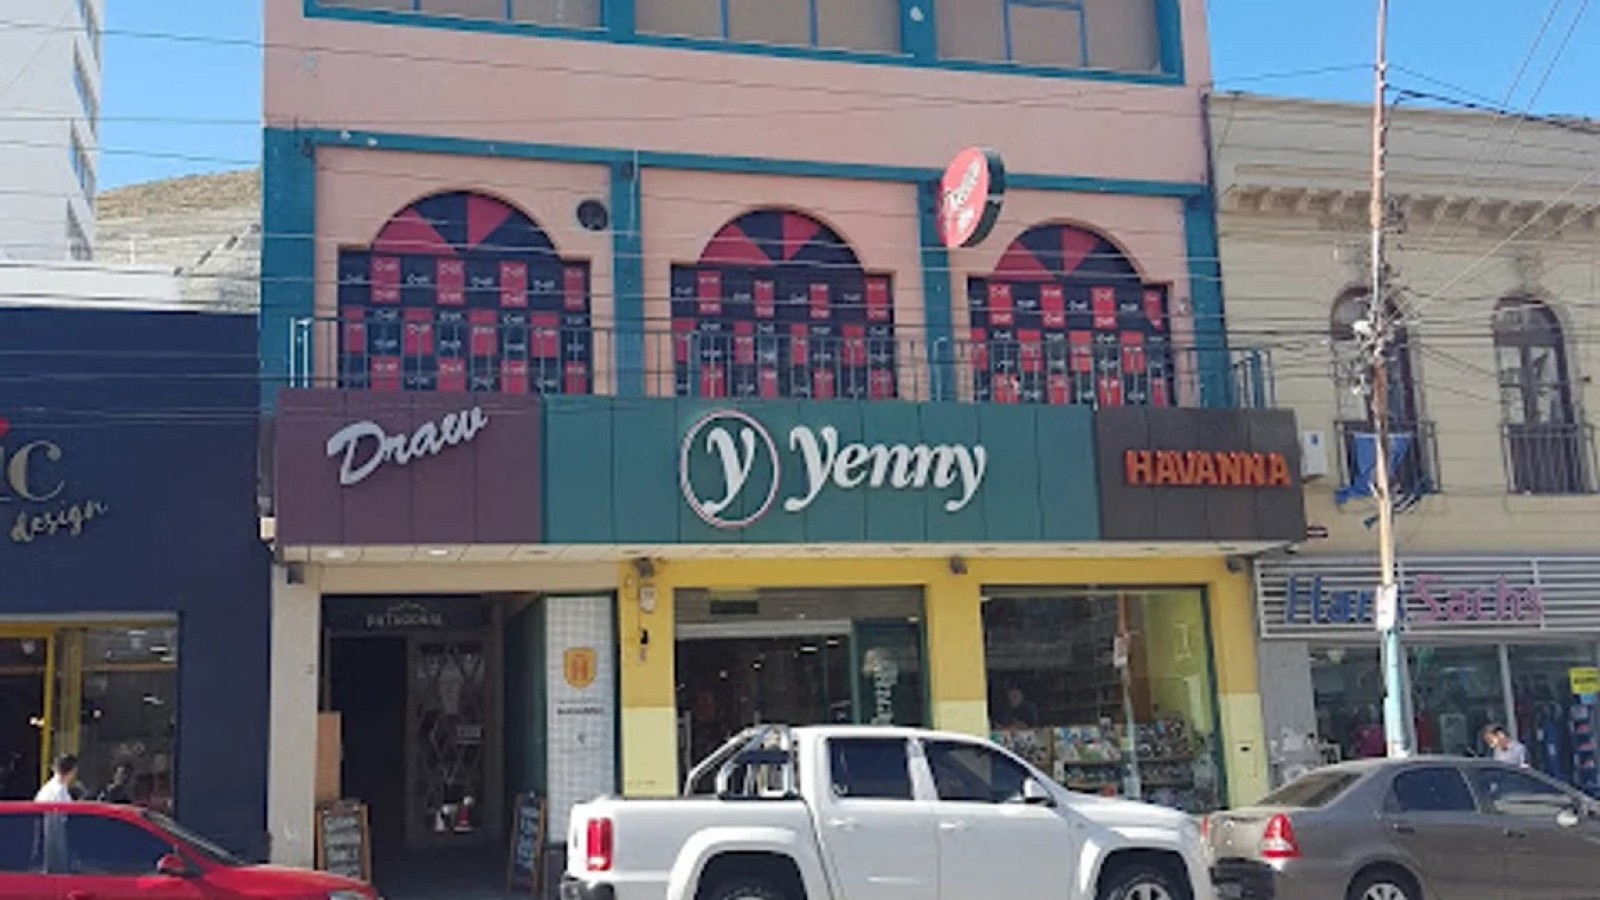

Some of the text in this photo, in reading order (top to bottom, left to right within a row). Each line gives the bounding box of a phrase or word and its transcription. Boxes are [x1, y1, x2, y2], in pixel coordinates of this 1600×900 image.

[327, 406, 488, 485] Draw
[1125, 450, 1292, 486] HAVANNA
[10, 500, 109, 542] design
